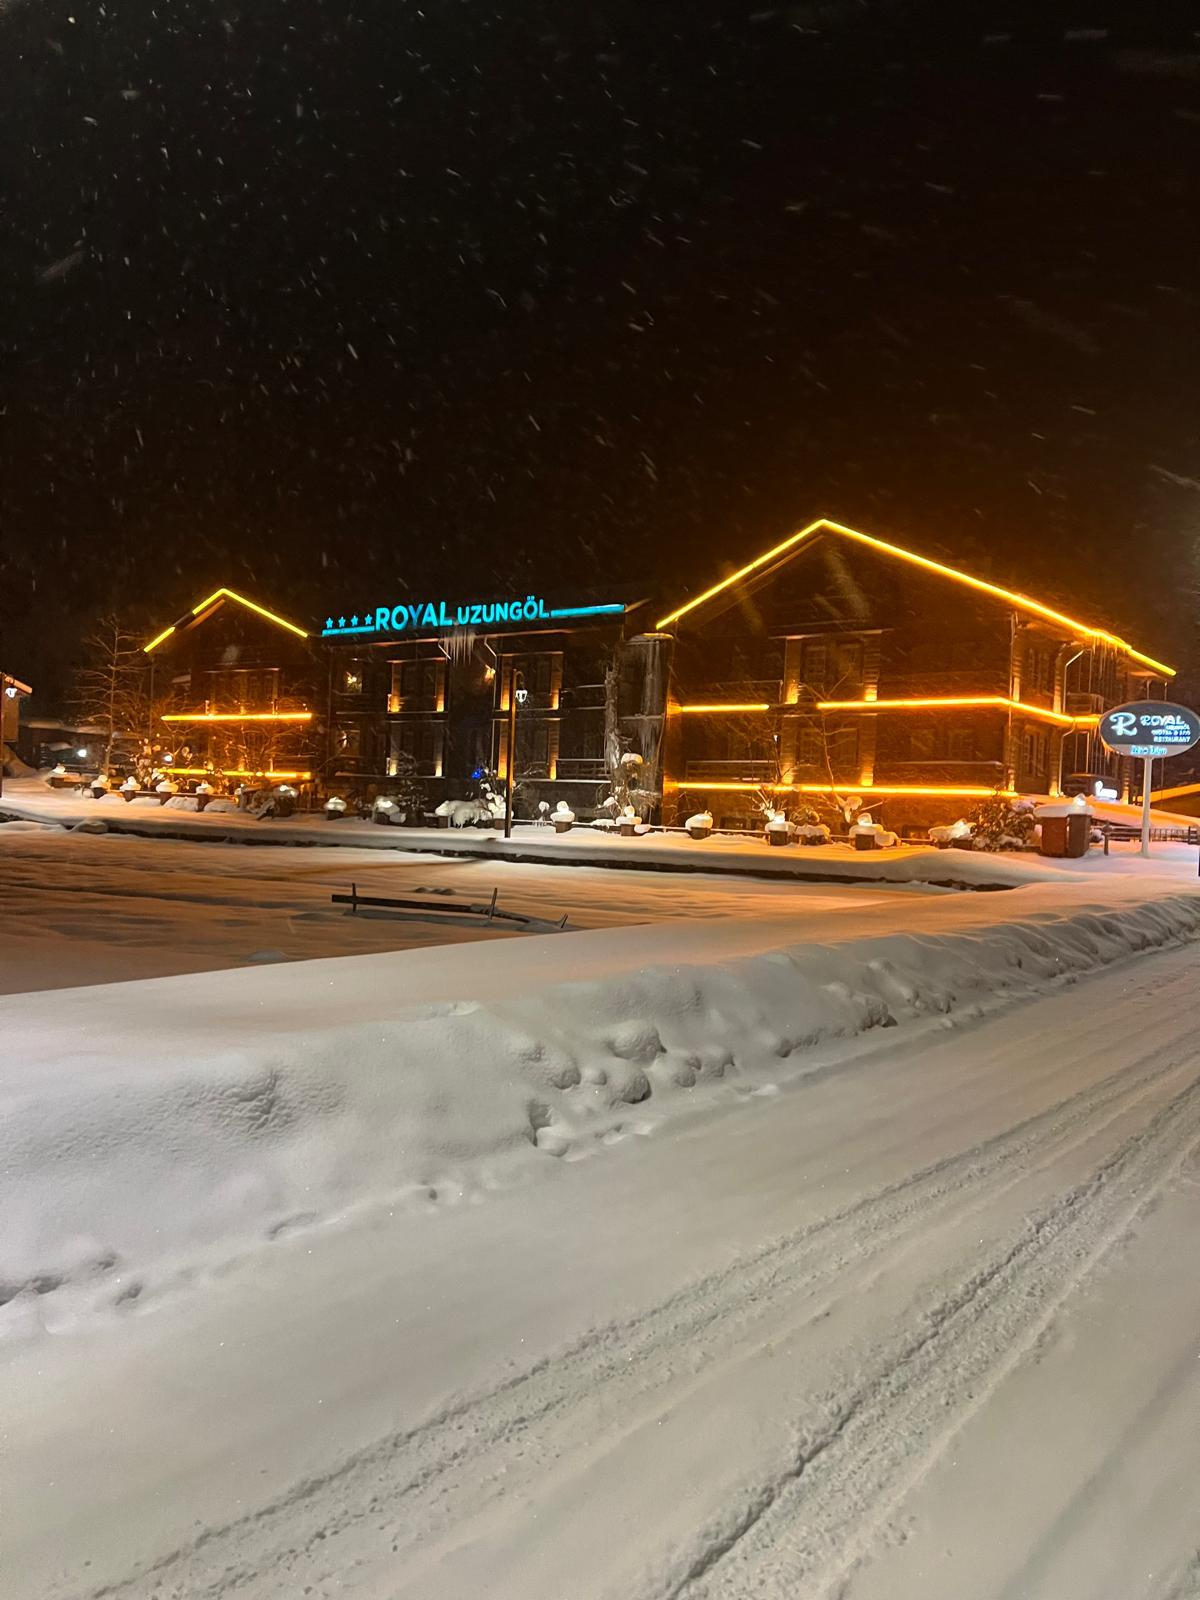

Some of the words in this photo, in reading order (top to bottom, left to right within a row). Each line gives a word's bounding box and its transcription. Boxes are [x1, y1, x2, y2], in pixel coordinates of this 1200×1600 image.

[375, 601, 453, 631] ROYAL
[457, 596, 549, 625] UZUNGÖL
[1140, 714, 1185, 726] ROYAL
